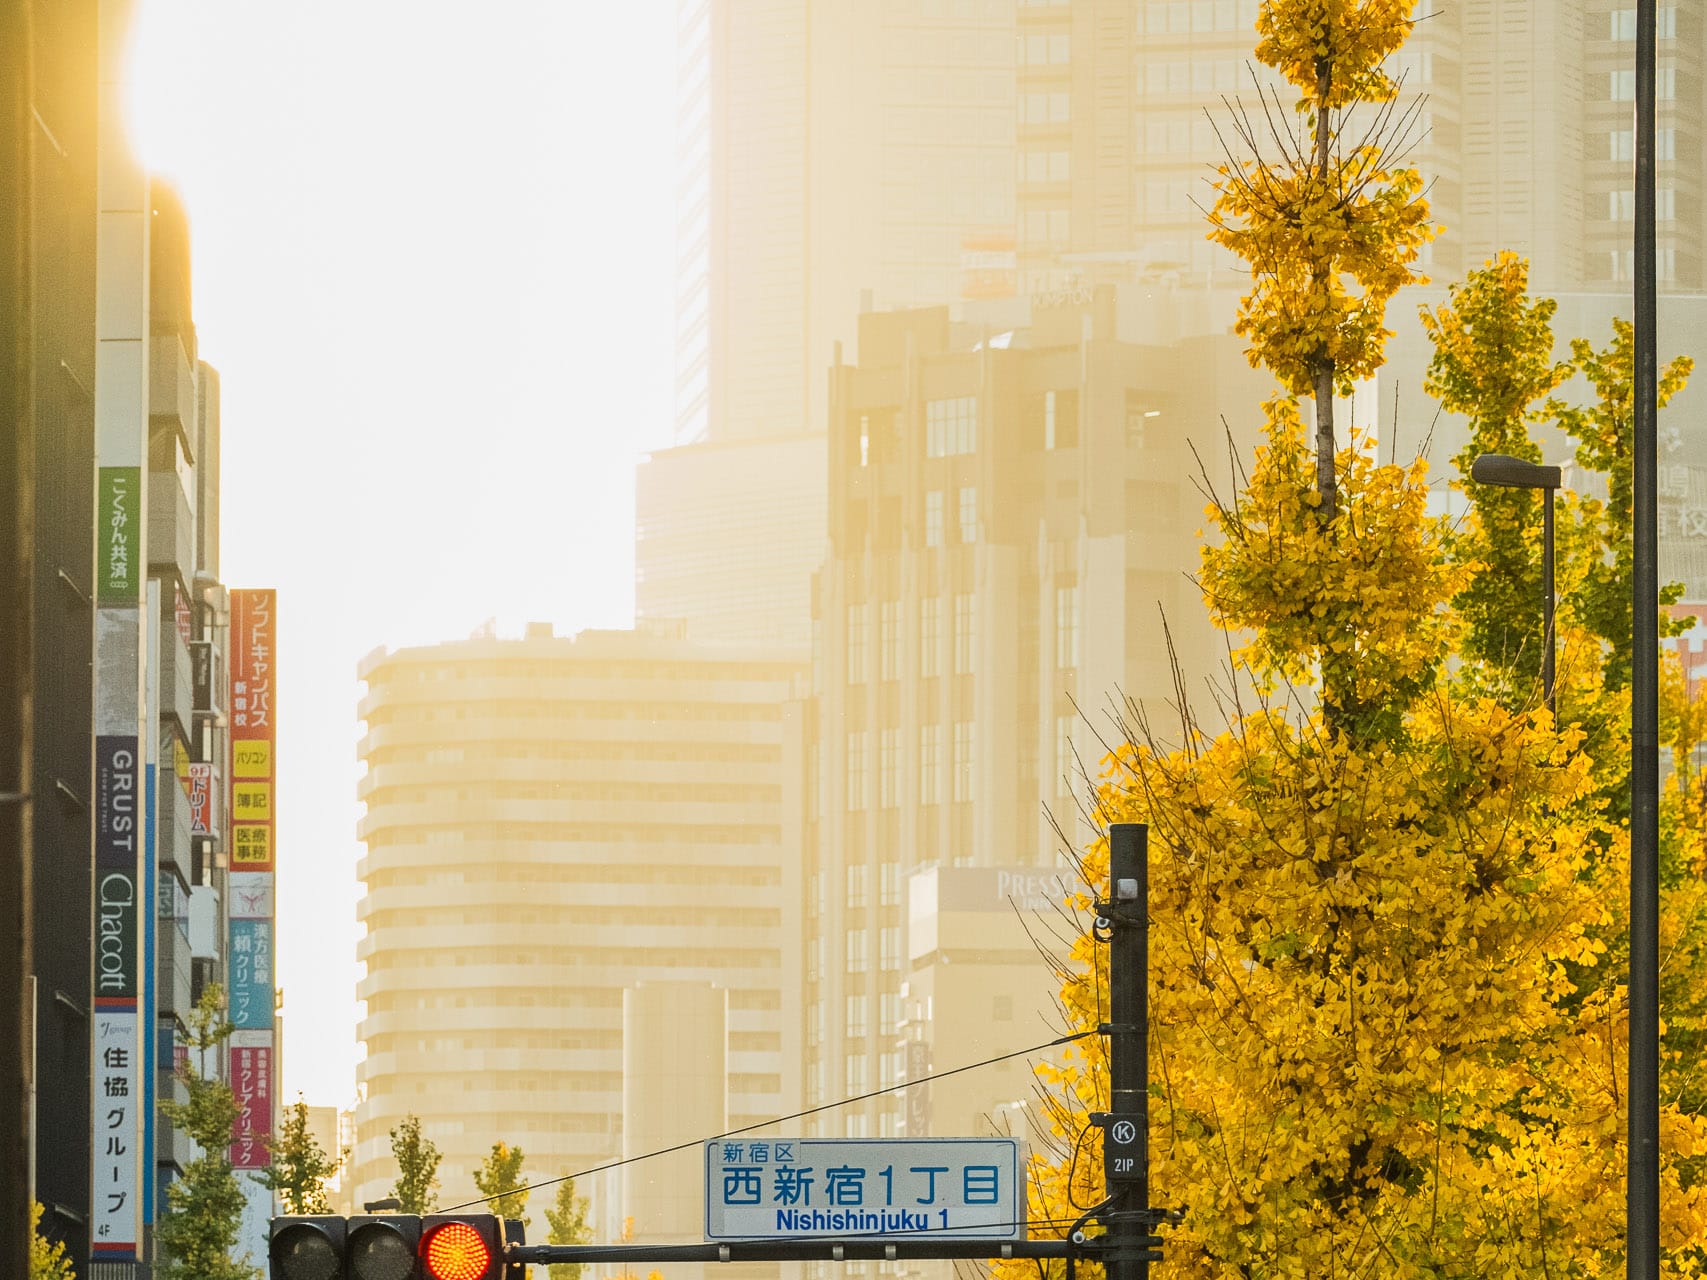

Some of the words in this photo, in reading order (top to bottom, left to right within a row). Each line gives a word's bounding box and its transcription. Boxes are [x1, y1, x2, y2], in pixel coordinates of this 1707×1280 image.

[111, 478, 128, 578] こくみん共済
[251, 592, 269, 727] ソフトキャンパス
[234, 681, 247, 727] 新宿校
[236, 751, 267, 764] パソコン
[112, 750, 133, 851] GRUST
[192, 778, 206, 832] ドリーム
[236, 793, 267, 808] 簿記
[236, 828, 267, 843] 医療
[236, 845, 267, 860] 事務
[998, 870, 1079, 899] PRESSO
[99, 873, 133, 990] Chacott
[104, 1047, 128, 1214] 住協グループ
[723, 1142, 796, 1163] 新宿区
[721, 1164, 999, 1206] 西新宿1丁目
[98, 1224, 110, 1237] 4F
[776, 1209, 928, 1233] Nishishinjuku
[938, 1209, 949, 1229] 1
